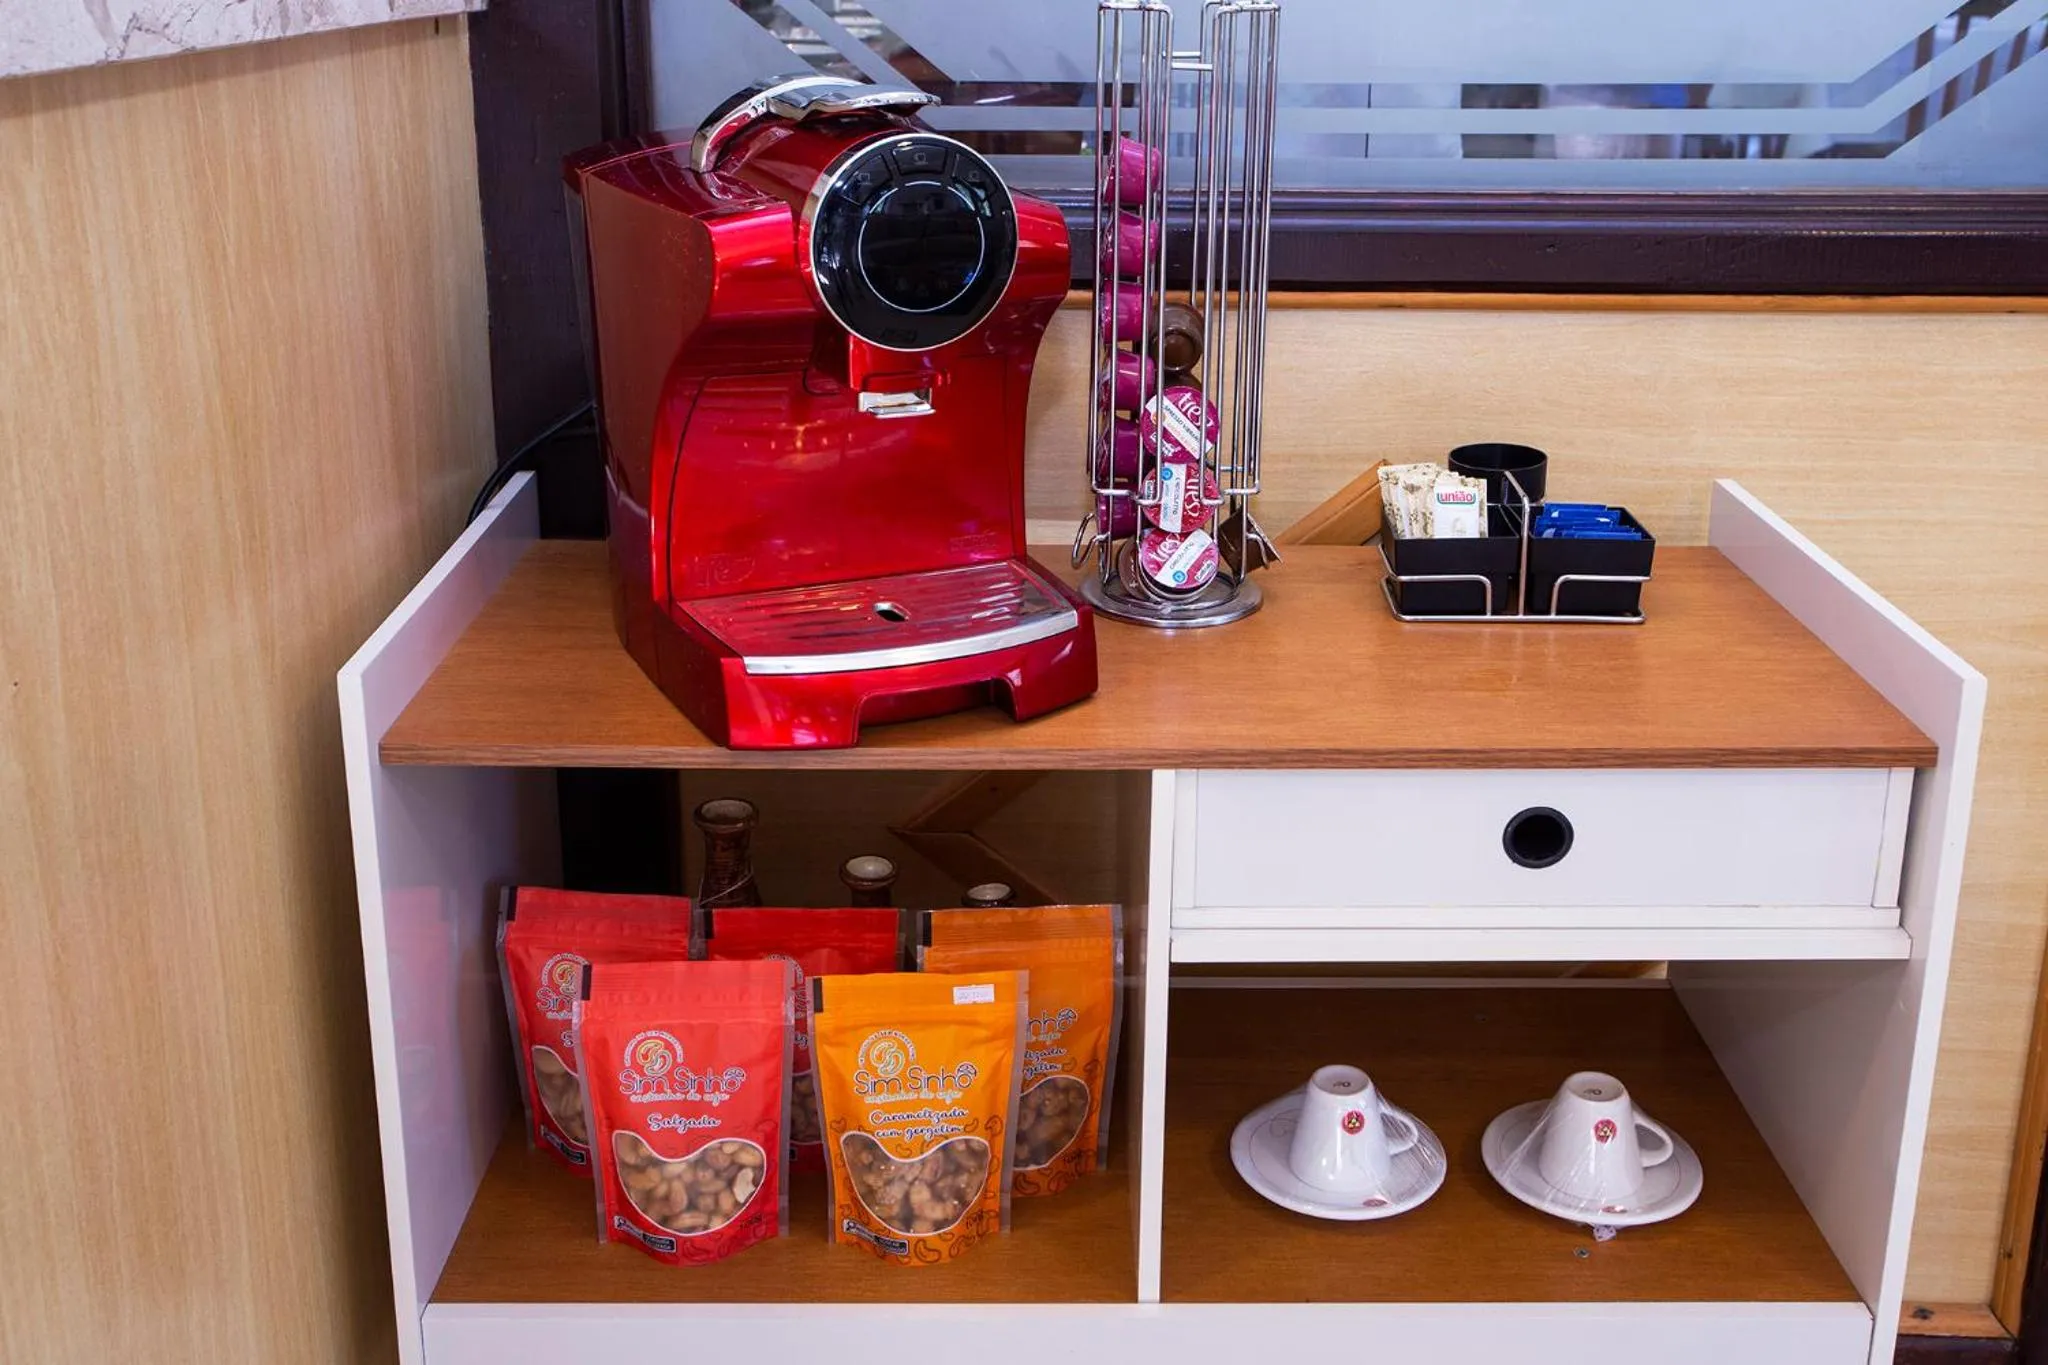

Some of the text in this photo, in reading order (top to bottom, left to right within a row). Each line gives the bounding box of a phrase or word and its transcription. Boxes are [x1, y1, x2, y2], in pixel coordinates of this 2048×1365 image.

[620, 1069, 669, 1094] Sim
[854, 1070, 903, 1095] Sim
[647, 1112, 721, 1134] Salgada
[869, 1106, 968, 1125] Caramelizada
[875, 1123, 962, 1141] com gergelim
